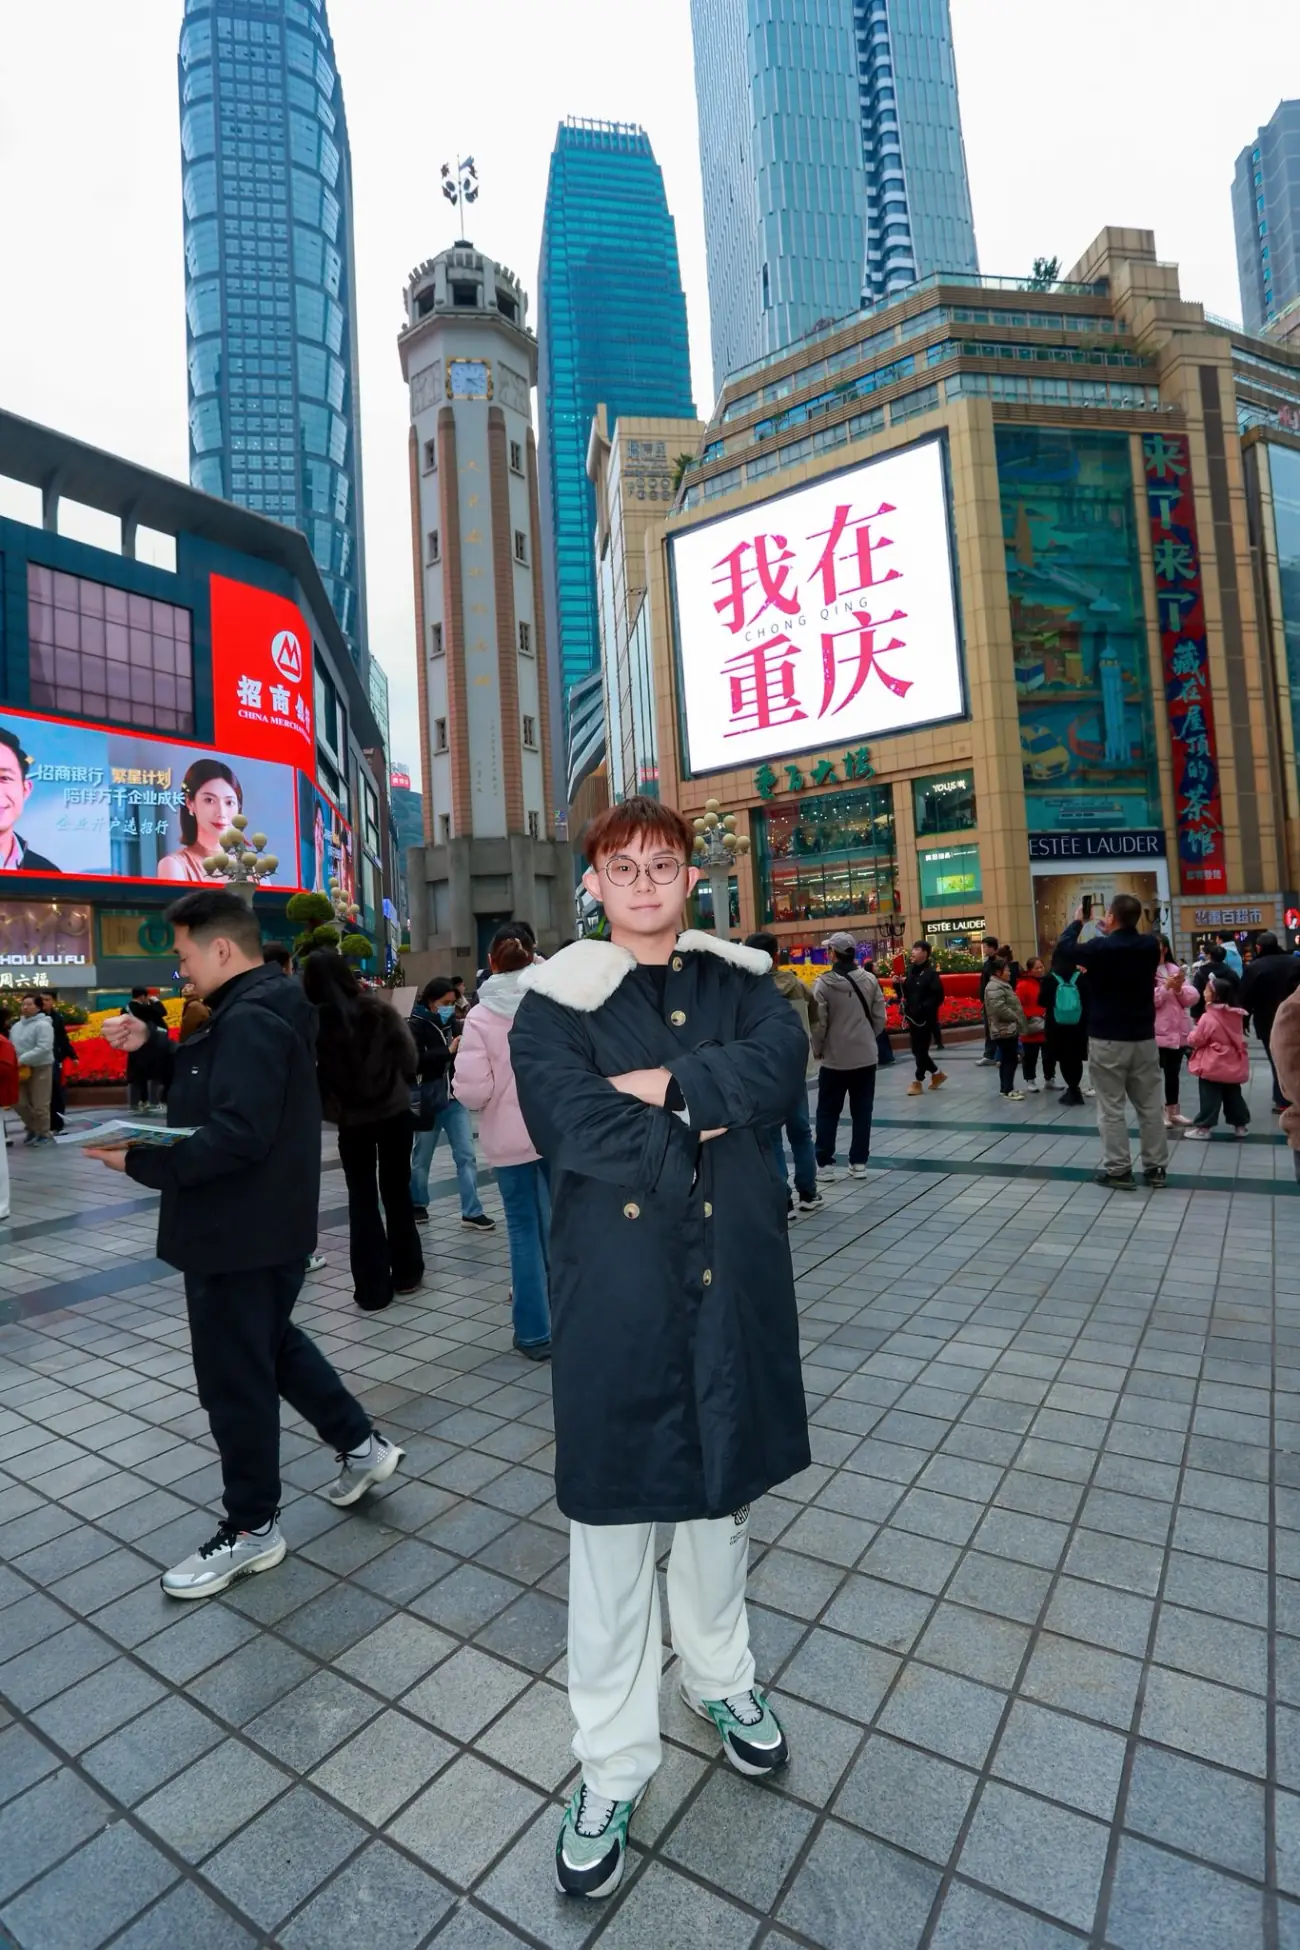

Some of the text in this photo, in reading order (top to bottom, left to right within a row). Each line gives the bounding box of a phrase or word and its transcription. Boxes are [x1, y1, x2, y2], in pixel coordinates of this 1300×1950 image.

[711, 502, 904, 635] 我在
[745, 597, 869, 642] CHONG QING
[720, 608, 914, 738] 重庆
[237, 674, 311, 734] 招商
[238, 709, 269, 723] CHINA
[27, 764, 172, 790] 招商银行 繁星计划
[64, 787, 186, 812] 陪伴万千企业成长
[1087, 836, 1159, 854] LAUDER
[953, 920, 986, 931] LAUDER
[38, 954, 61, 965] LIU
[65, 954, 85, 965] FU
[0, 972, 50, 988] 周六福
